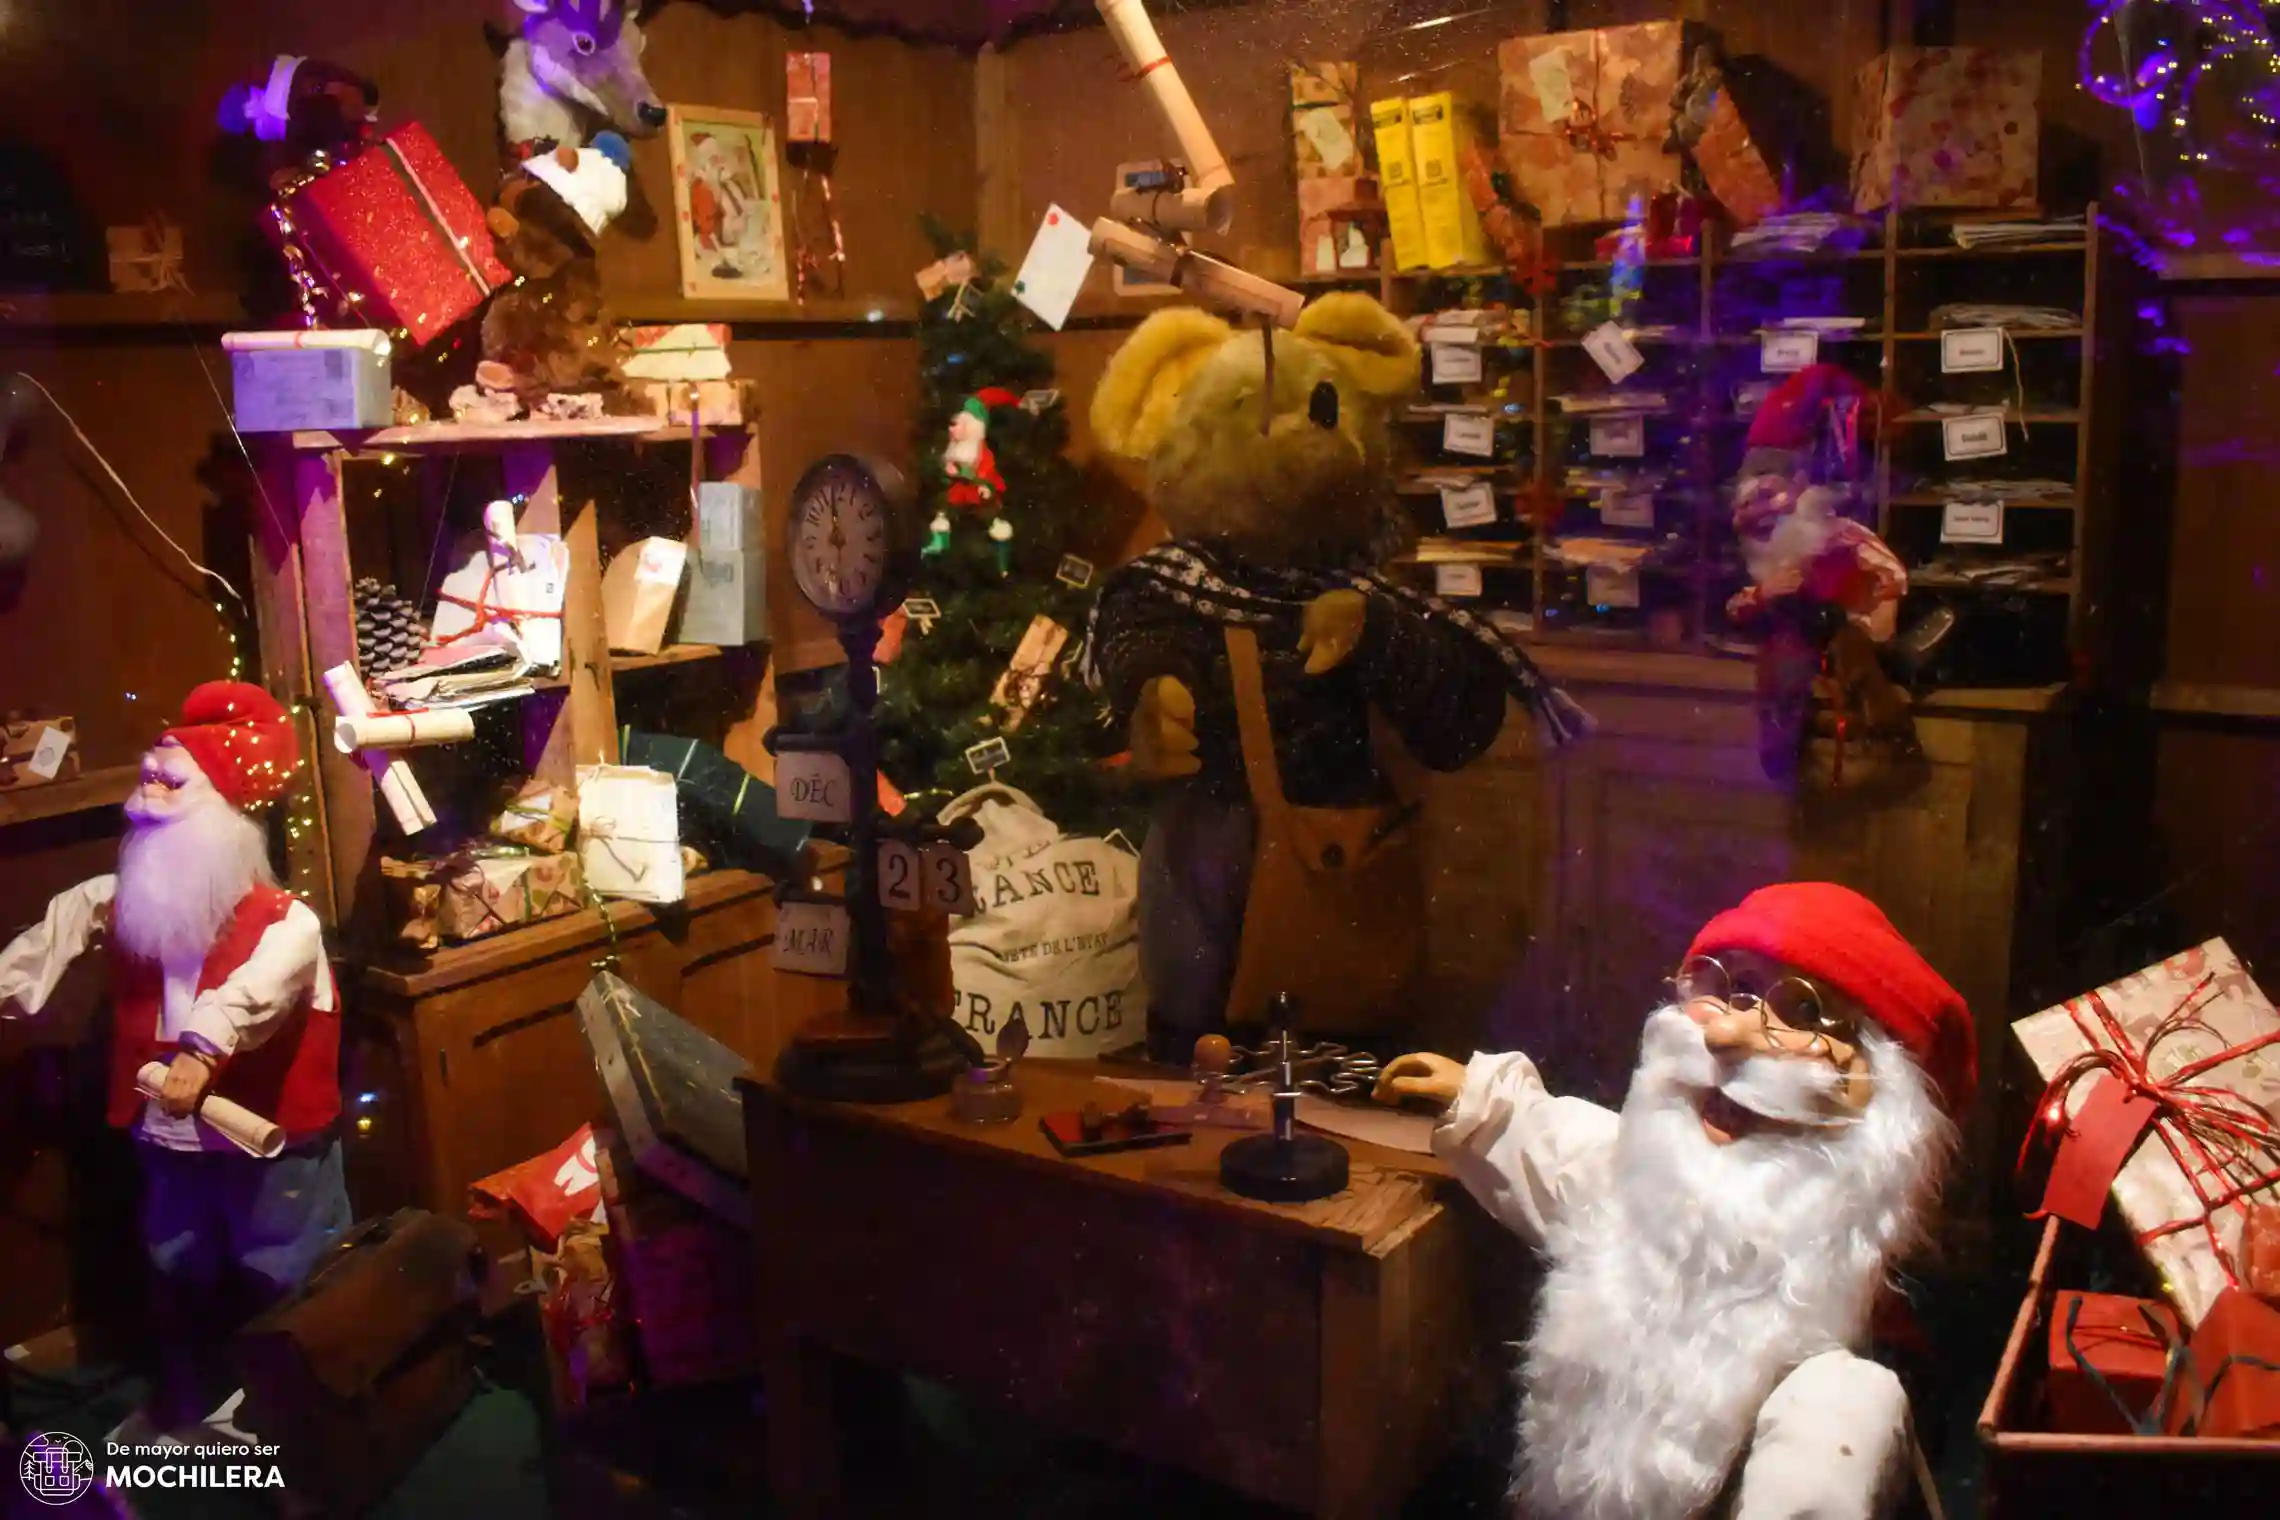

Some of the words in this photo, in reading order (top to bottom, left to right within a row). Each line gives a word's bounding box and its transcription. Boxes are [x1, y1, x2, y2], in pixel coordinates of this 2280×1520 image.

[790, 773, 834, 807] DÉC
[783, 927, 834, 957] MAR
[953, 989, 1125, 1040] RANCE
